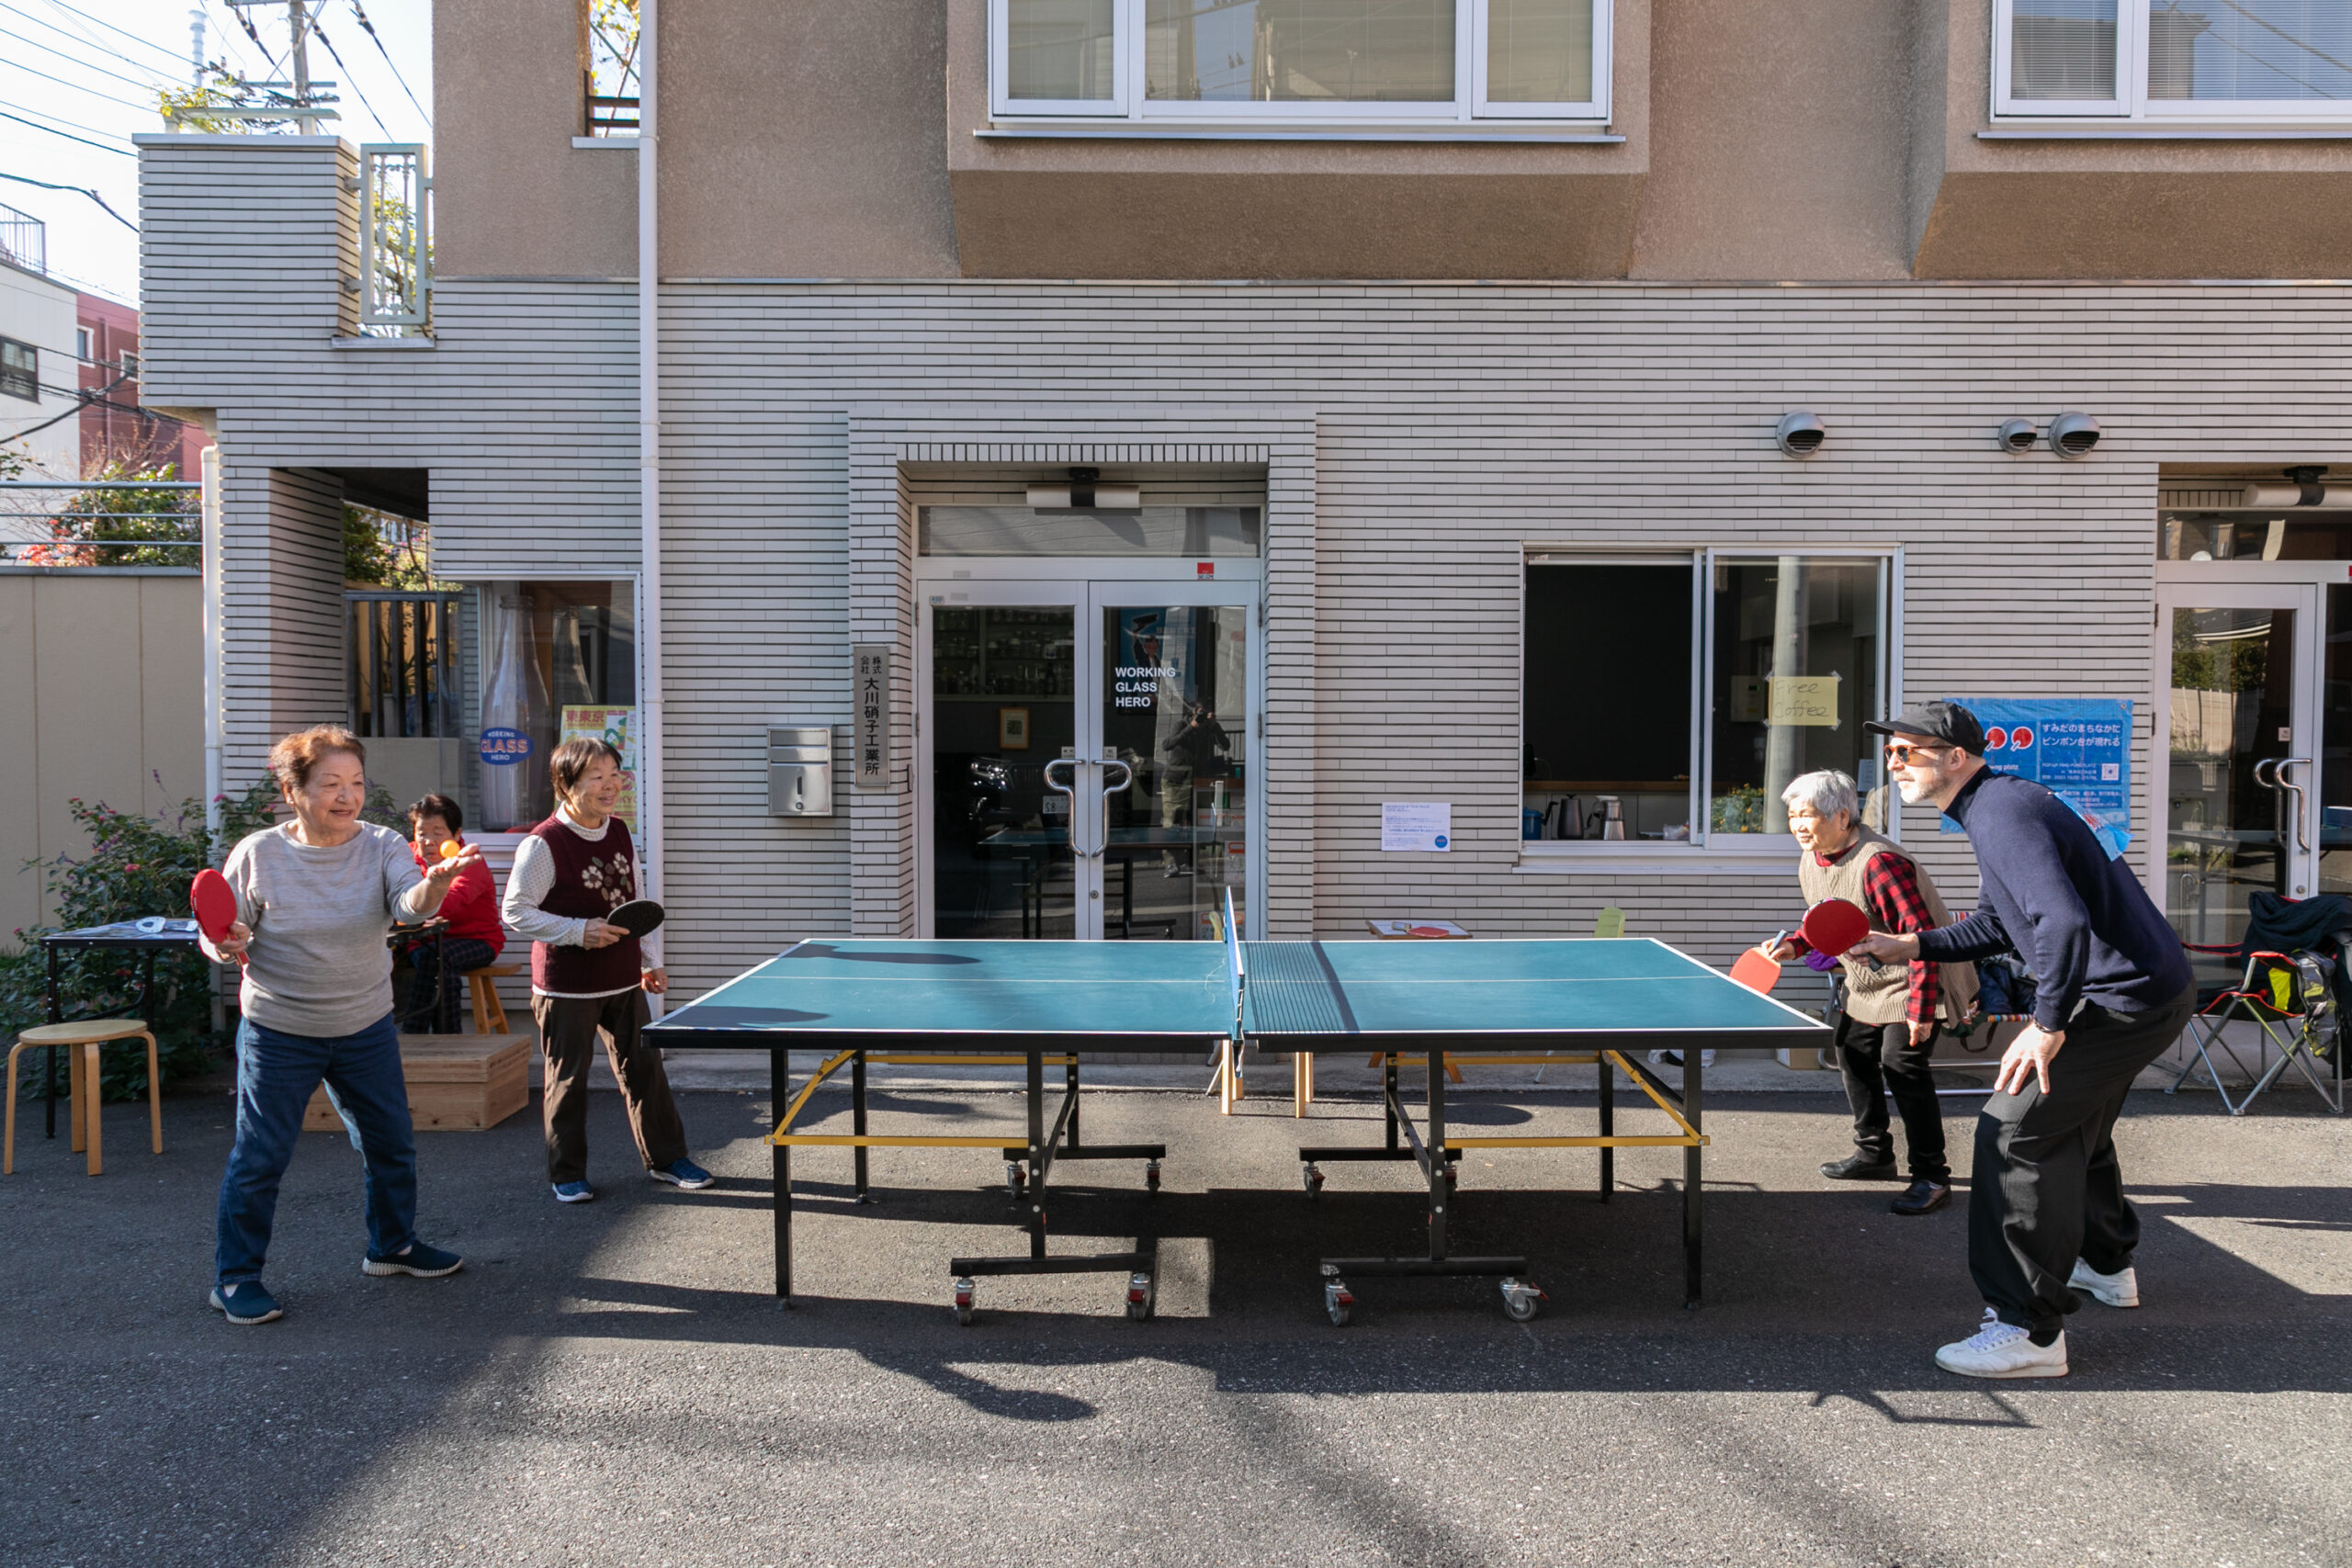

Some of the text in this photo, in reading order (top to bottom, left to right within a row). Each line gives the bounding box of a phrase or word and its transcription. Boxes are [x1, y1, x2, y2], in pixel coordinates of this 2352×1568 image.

[1114, 667, 1176, 678] WORKING
[1115, 682, 1158, 692] GLASS
[1775, 680, 1821, 694] Free
[1115, 697, 1151, 707] HERO
[1773, 700, 1829, 718] Coffee
[566, 710, 605, 723] 東東京
[864, 677, 879, 775] 大川硝子工業所
[2041, 724, 2121, 734] すみだのまちなかに
[481, 739, 529, 753] GLASS
[2041, 737, 2121, 747] ピンポン台が現れる
